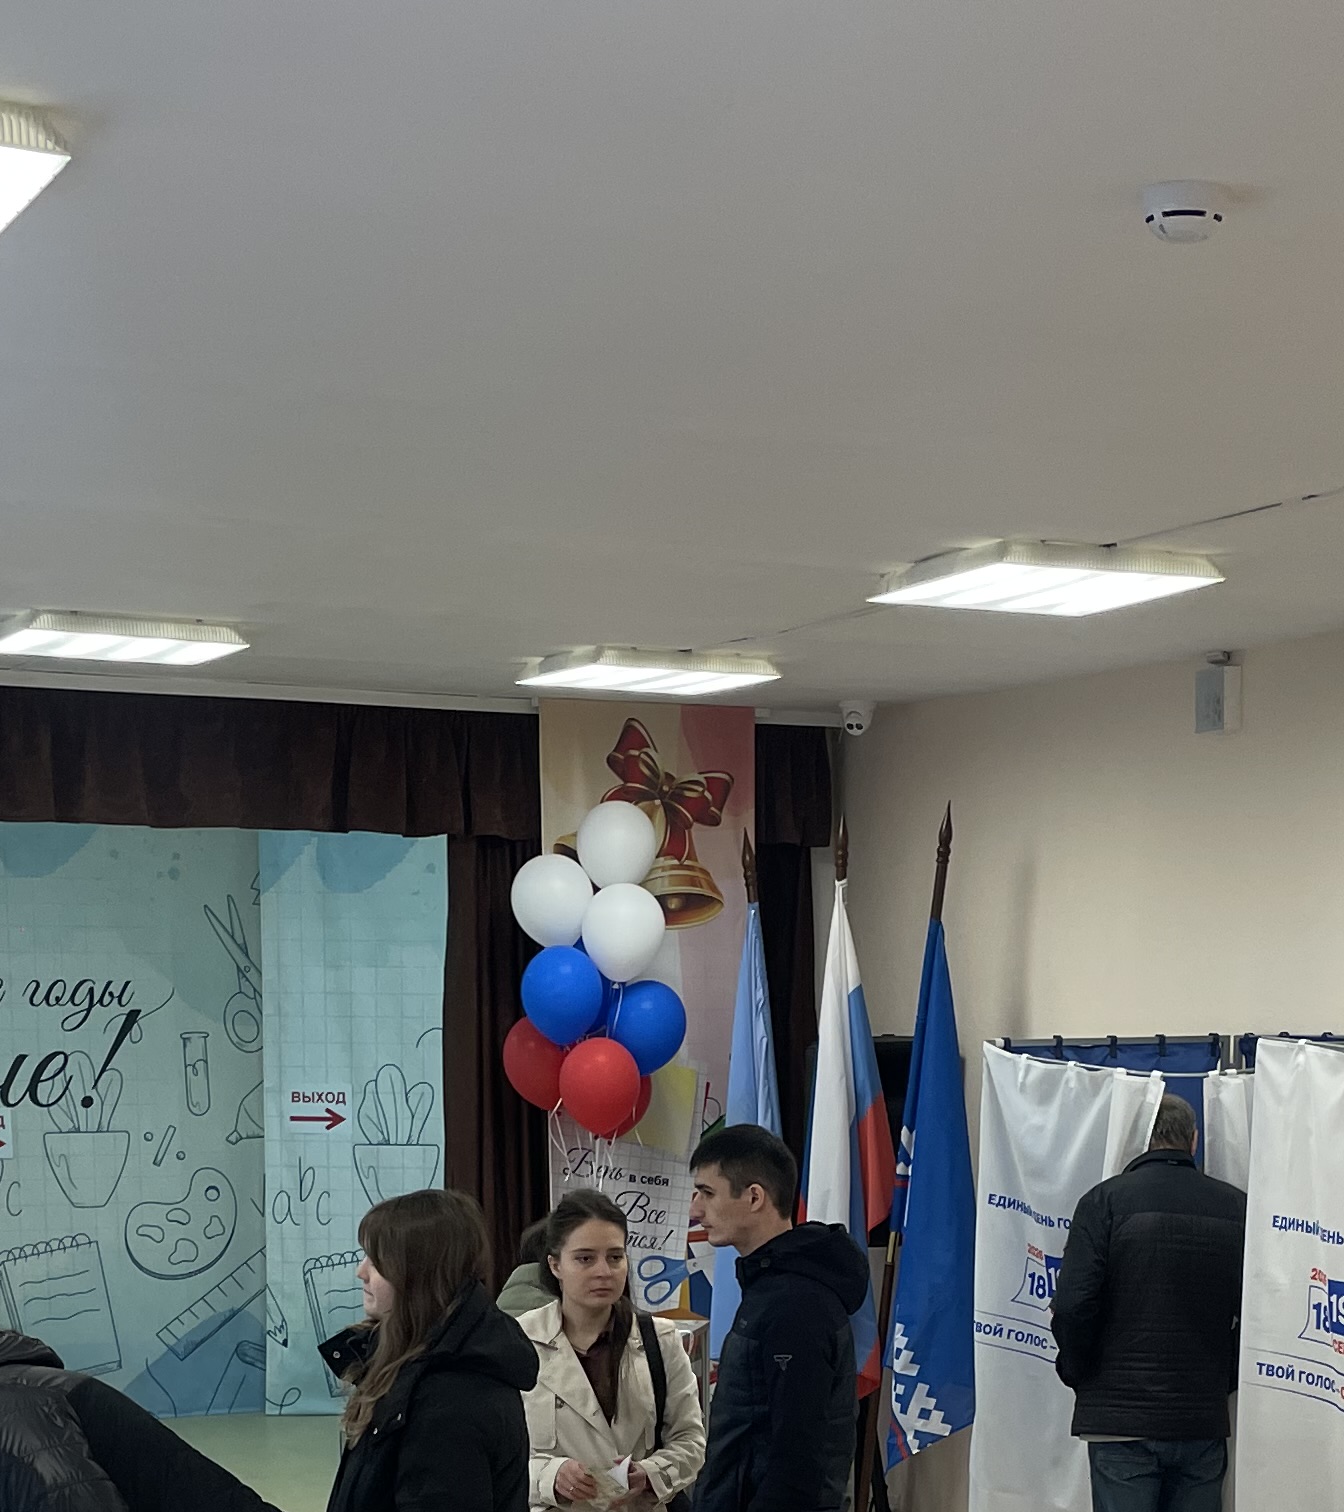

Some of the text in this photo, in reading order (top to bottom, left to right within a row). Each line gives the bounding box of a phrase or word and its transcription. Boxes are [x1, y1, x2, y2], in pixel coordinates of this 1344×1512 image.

[22, 978, 136, 1032] годы
[291, 1091, 346, 1106] ВЫХОД
[640, 1174, 670, 1187] себя
[615, 1190, 667, 1225] Все
[1027, 1271, 1047, 1300] 18
[973, 1320, 1003, 1339] ВОЙ
[1006, 1328, 1048, 1350] ГОЛОС
[1256, 1362, 1295, 1381] ТВОЙ
